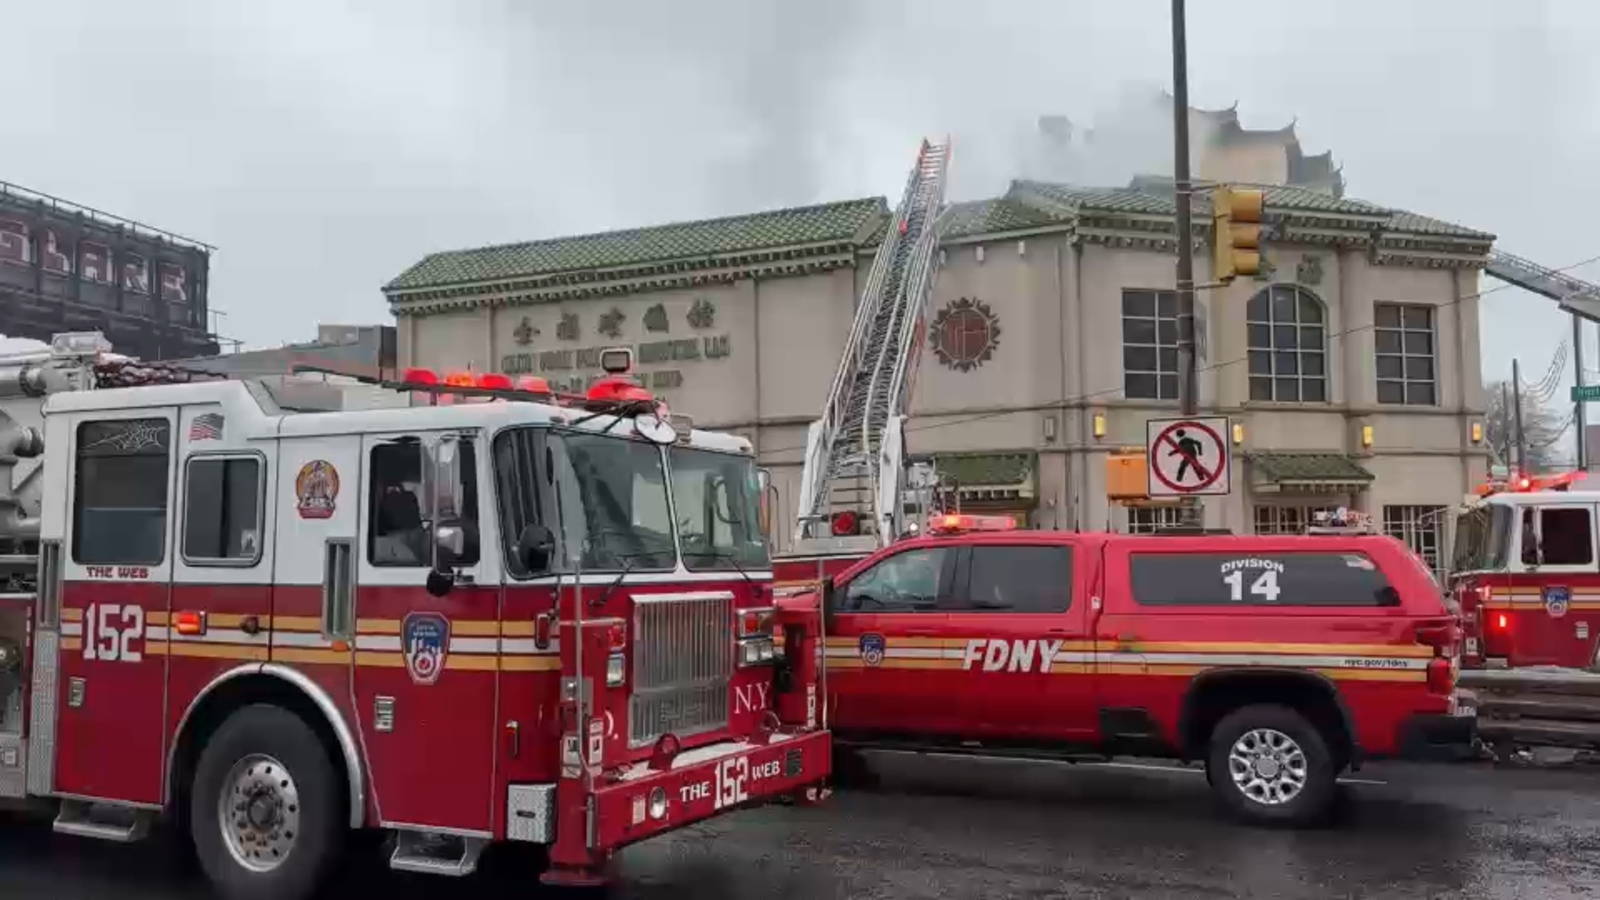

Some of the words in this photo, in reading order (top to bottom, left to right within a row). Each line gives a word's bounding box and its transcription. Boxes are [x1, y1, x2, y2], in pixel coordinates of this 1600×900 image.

[86, 566, 113, 578] THE
[118, 567, 149, 579] WEB
[1221, 558, 1284, 573] DIVISION
[1224, 570, 1281, 601] 14
[83, 602, 144, 662] 152
[962, 639, 1064, 673] FDNY
[680, 781, 711, 802] THE
[714, 756, 748, 810] 152
[752, 761, 780, 780] WEB
